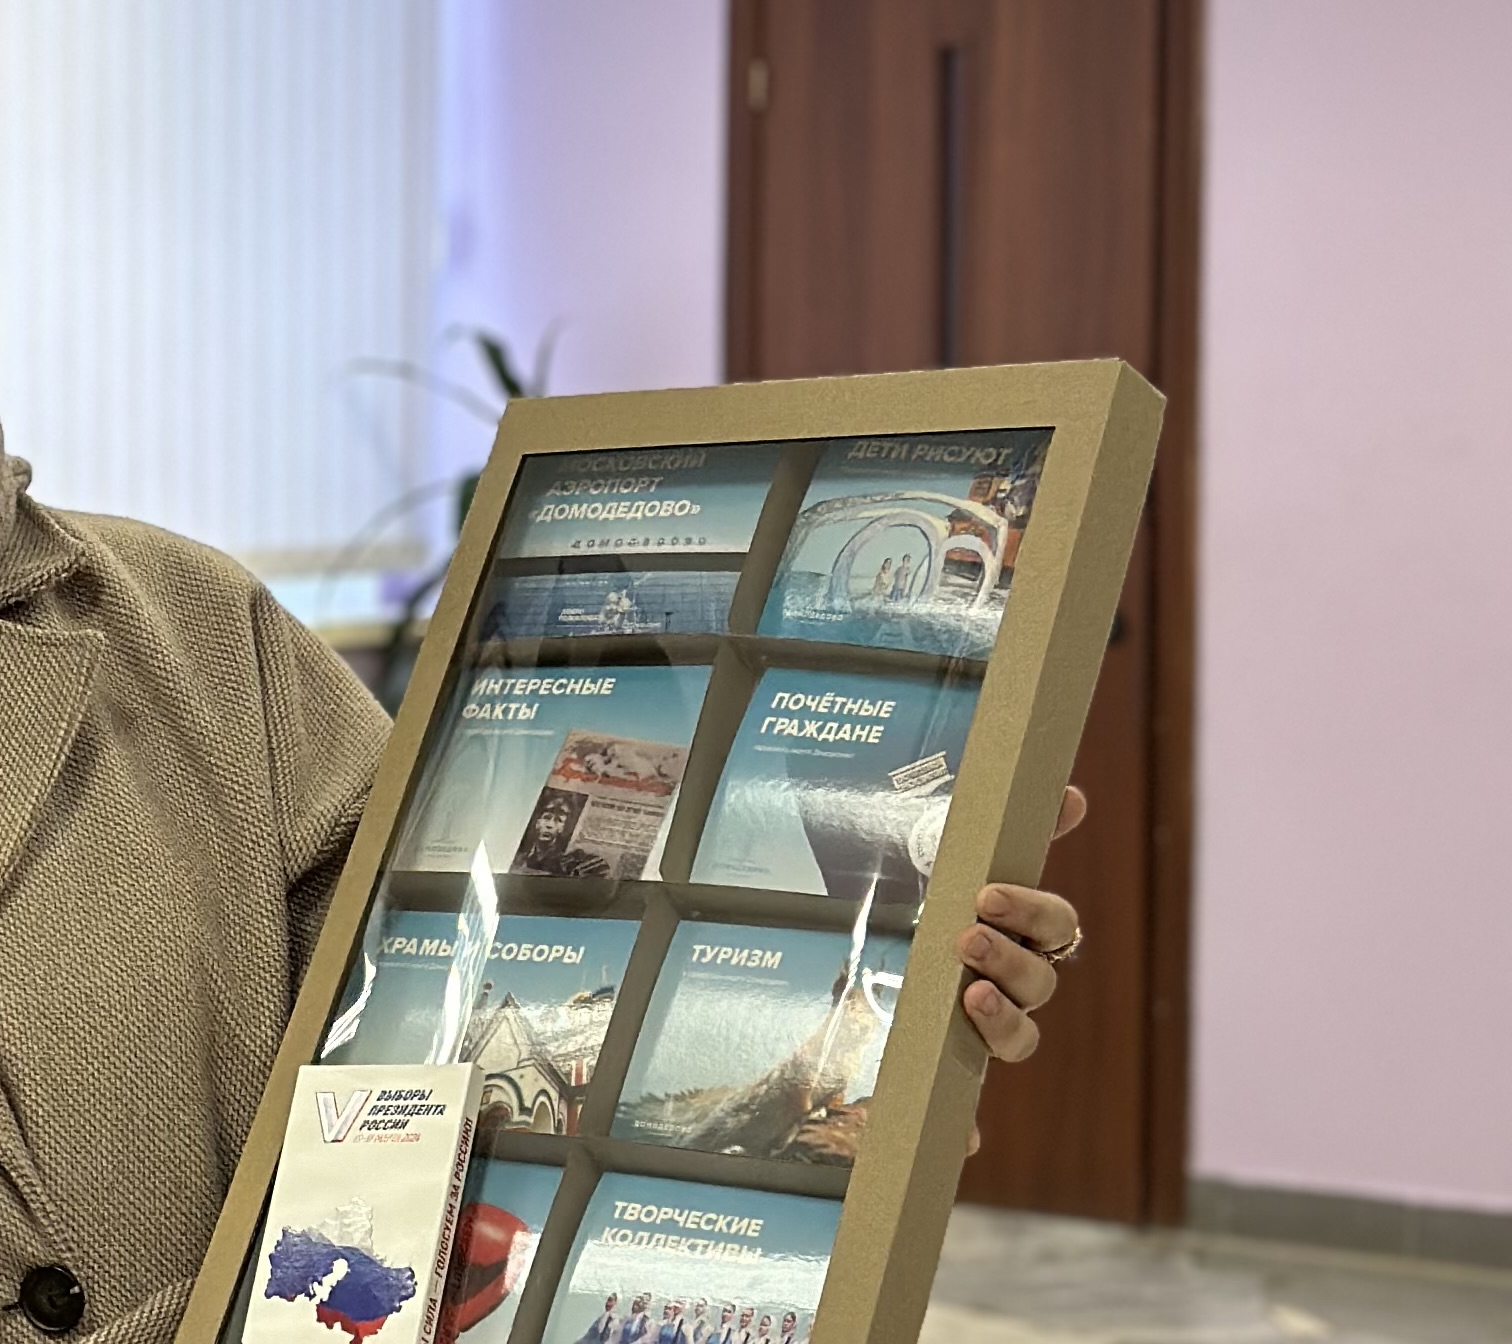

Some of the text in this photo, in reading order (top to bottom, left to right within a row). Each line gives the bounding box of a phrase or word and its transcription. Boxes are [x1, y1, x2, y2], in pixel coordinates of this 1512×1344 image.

[847, 440, 1014, 466] ДЕТИ РИСУЮТ
[546, 476, 664, 497] АЭРОПОРТ
[528, 499, 701, 523] «ДОМОДЕДОВО»
[471, 677, 617, 696] ИНТЕРЕСНЫЕ
[462, 702, 540, 721] ФАКТЫ
[771, 691, 897, 719] ПОЧЁТНЫЕ
[760, 716, 885, 744] ГРАЖДАНЕ
[377, 936, 459, 958] ХРАМЫ
[487, 941, 586, 965] СОБОРЫ
[691, 943, 783, 969] ТУРИЗМ
[376, 1089, 433, 1102] ВЫБОРЫ
[367, 1104, 447, 1117] ПРЕЗИДЕНТА
[359, 1119, 410, 1132] РОССИИ
[613, 1201, 764, 1238] ТВОРЧЕСКИЕ
[599, 1227, 763, 1265] КОЛЛЕКТИВЫ
[423, 1297, 438, 1337] СИЛА
[449, 1185, 461, 1202] ЗА
